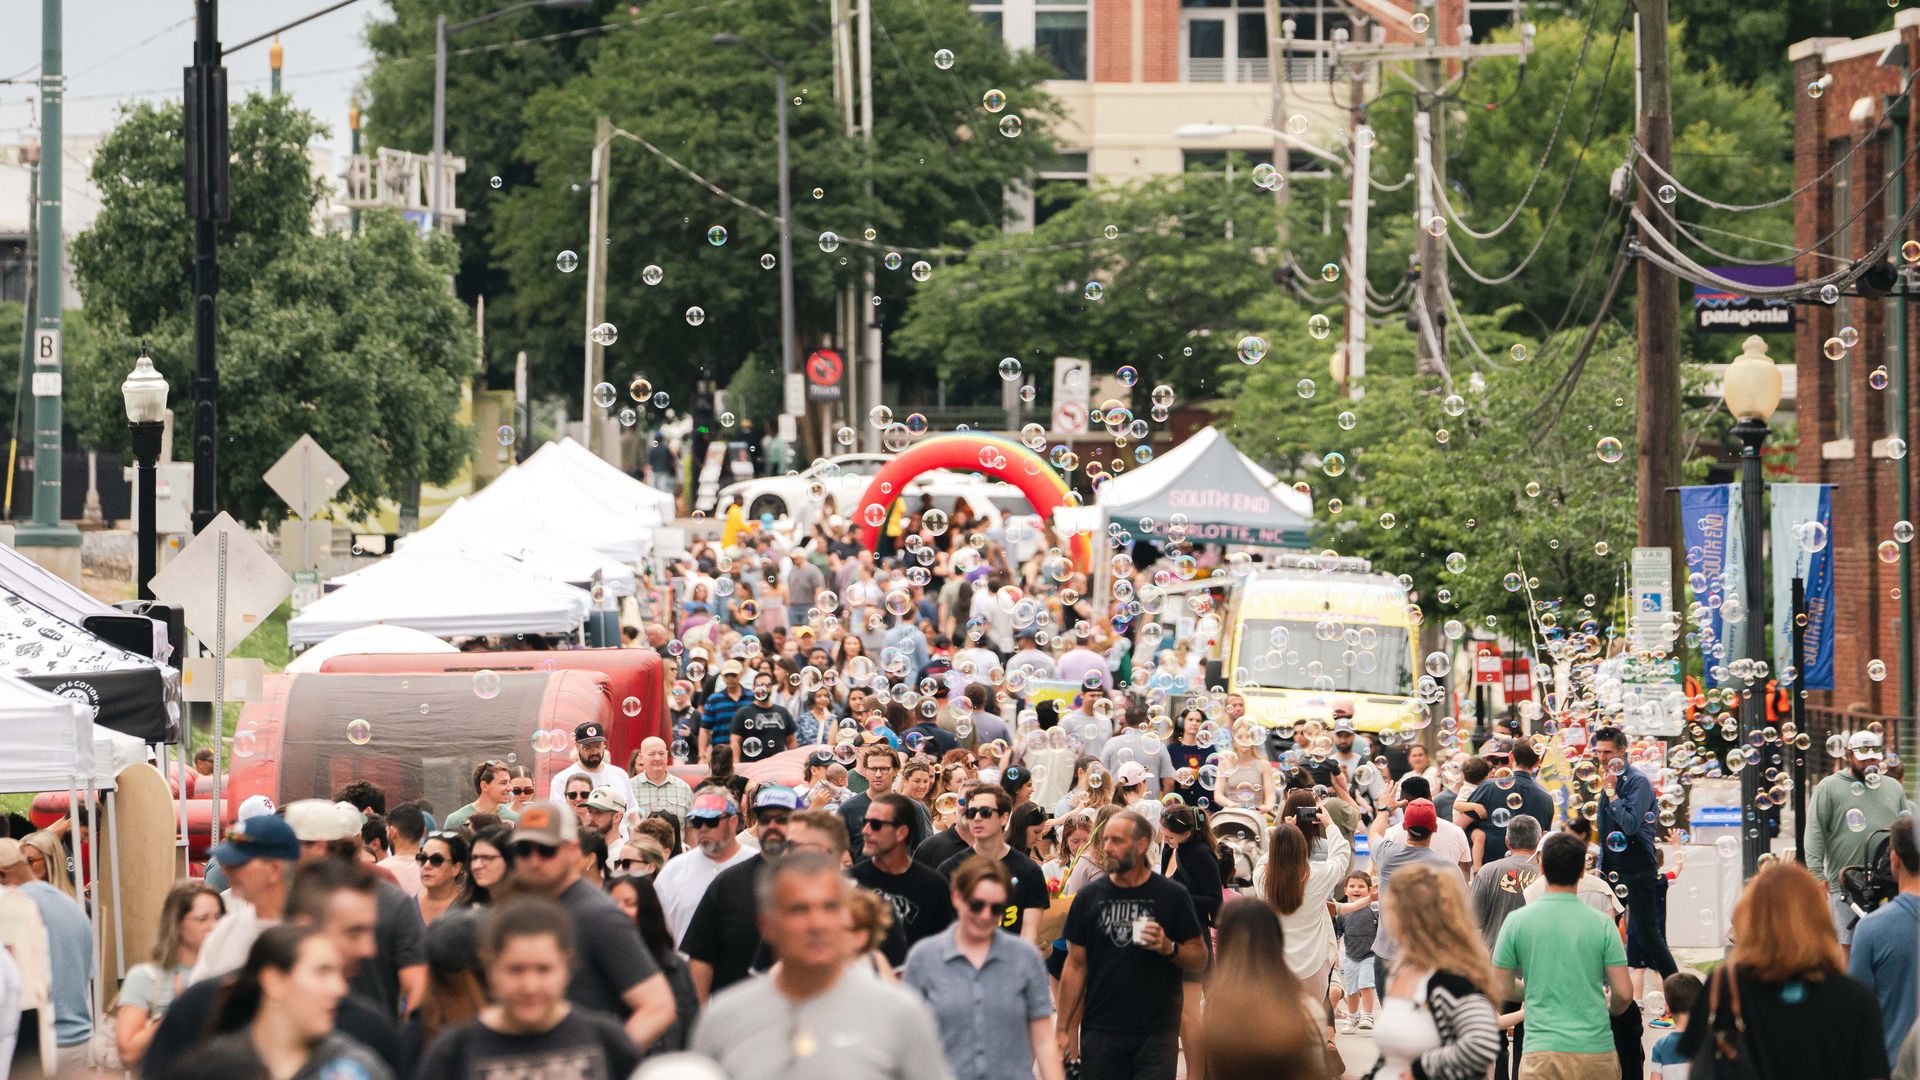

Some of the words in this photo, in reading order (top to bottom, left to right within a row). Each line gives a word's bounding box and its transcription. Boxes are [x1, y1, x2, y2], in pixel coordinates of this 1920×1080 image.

[1701, 307, 1783, 327] patagonia
[41, 335, 53, 358] B
[1168, 489, 1229, 509] SOUTH
[1232, 493, 1270, 513] END
